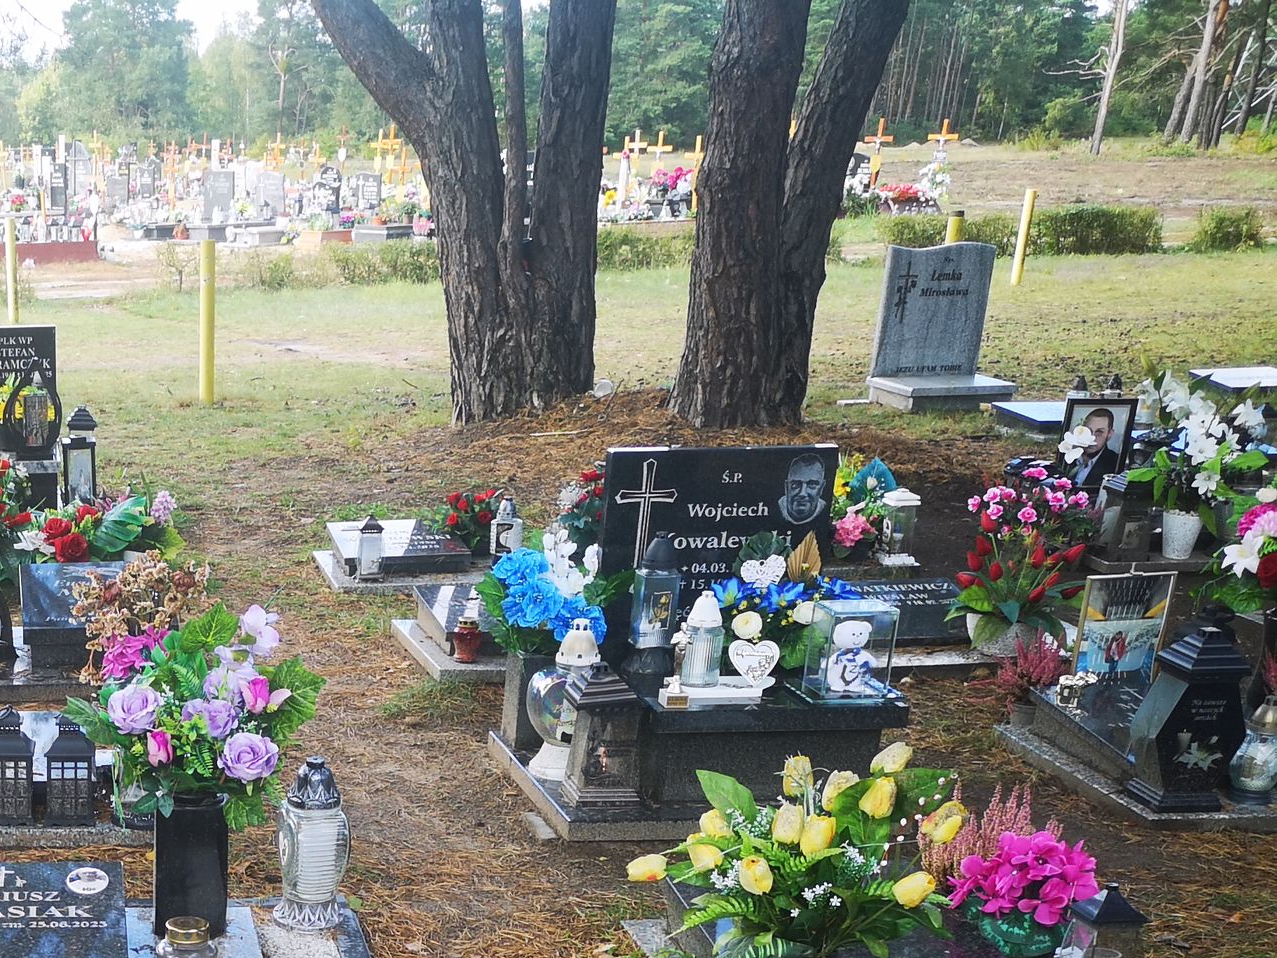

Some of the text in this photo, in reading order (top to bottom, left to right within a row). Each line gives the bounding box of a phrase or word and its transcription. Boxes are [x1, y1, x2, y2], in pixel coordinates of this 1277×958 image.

[18, 336, 33, 345] WP
[722, 470, 743, 484] Ś.P.
[687, 502, 769, 522] Wojciech
[691, 562, 730, 574] 04.03.
[850, 582, 953, 593] NATKIEWICZ
